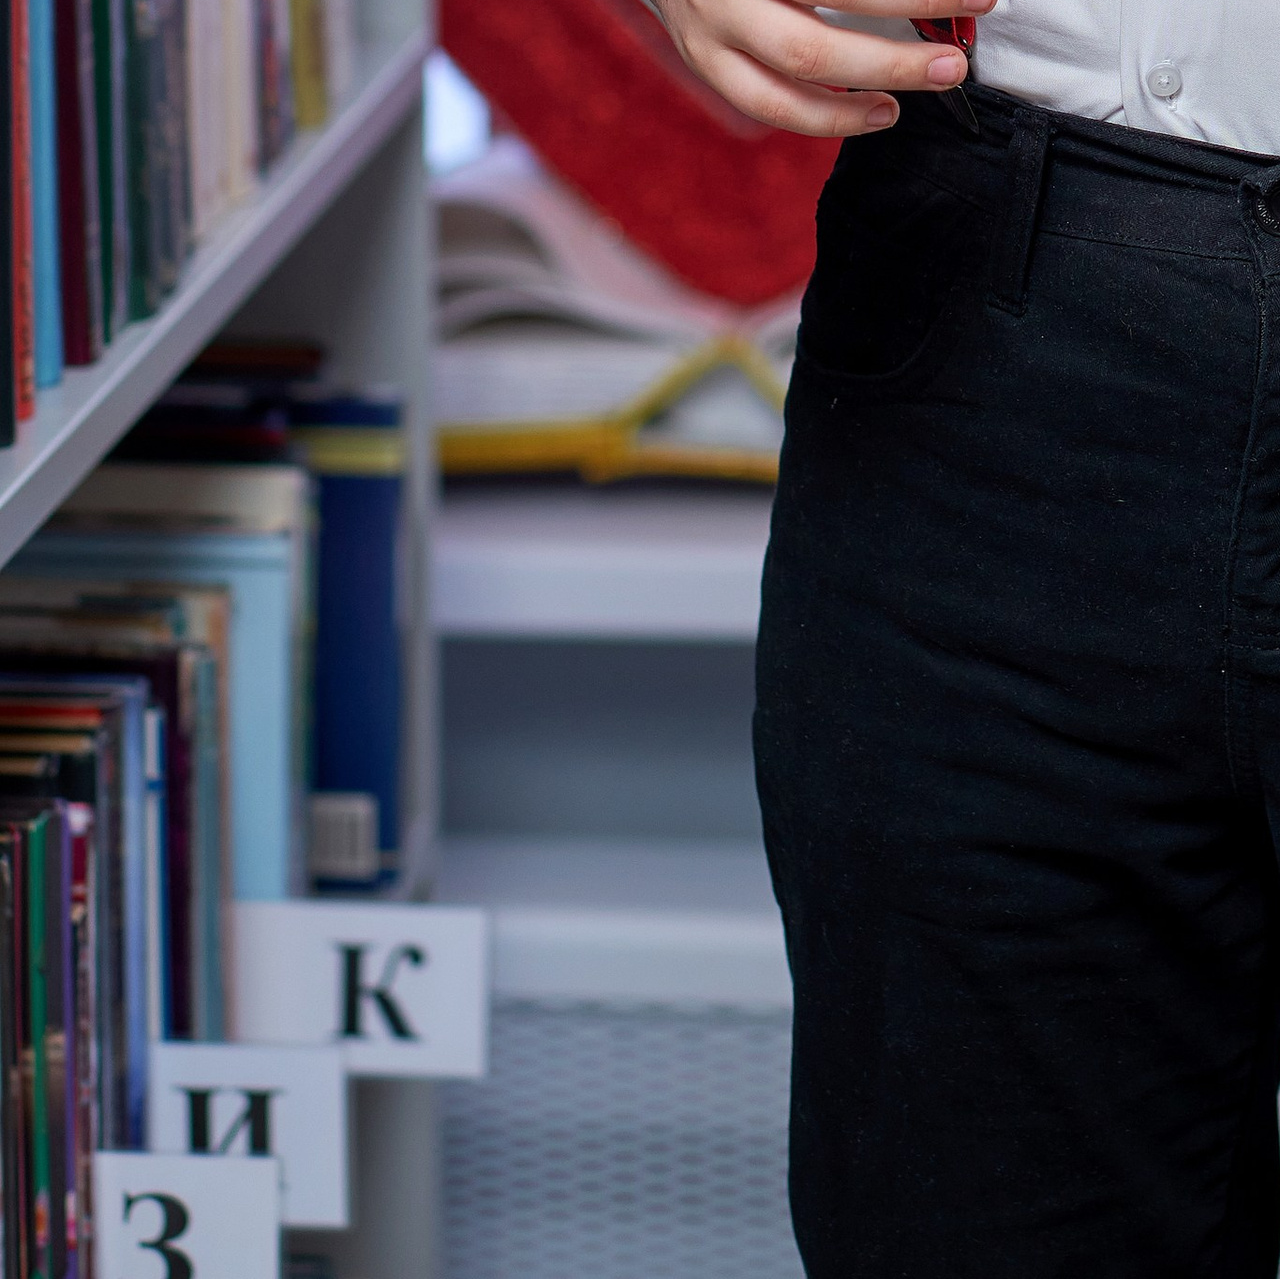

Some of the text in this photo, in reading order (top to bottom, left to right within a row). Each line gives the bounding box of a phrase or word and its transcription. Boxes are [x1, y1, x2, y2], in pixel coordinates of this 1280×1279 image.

[334, 942, 424, 1041] К
[178, 1084, 286, 1157] И
[122, 1191, 192, 1279] З
